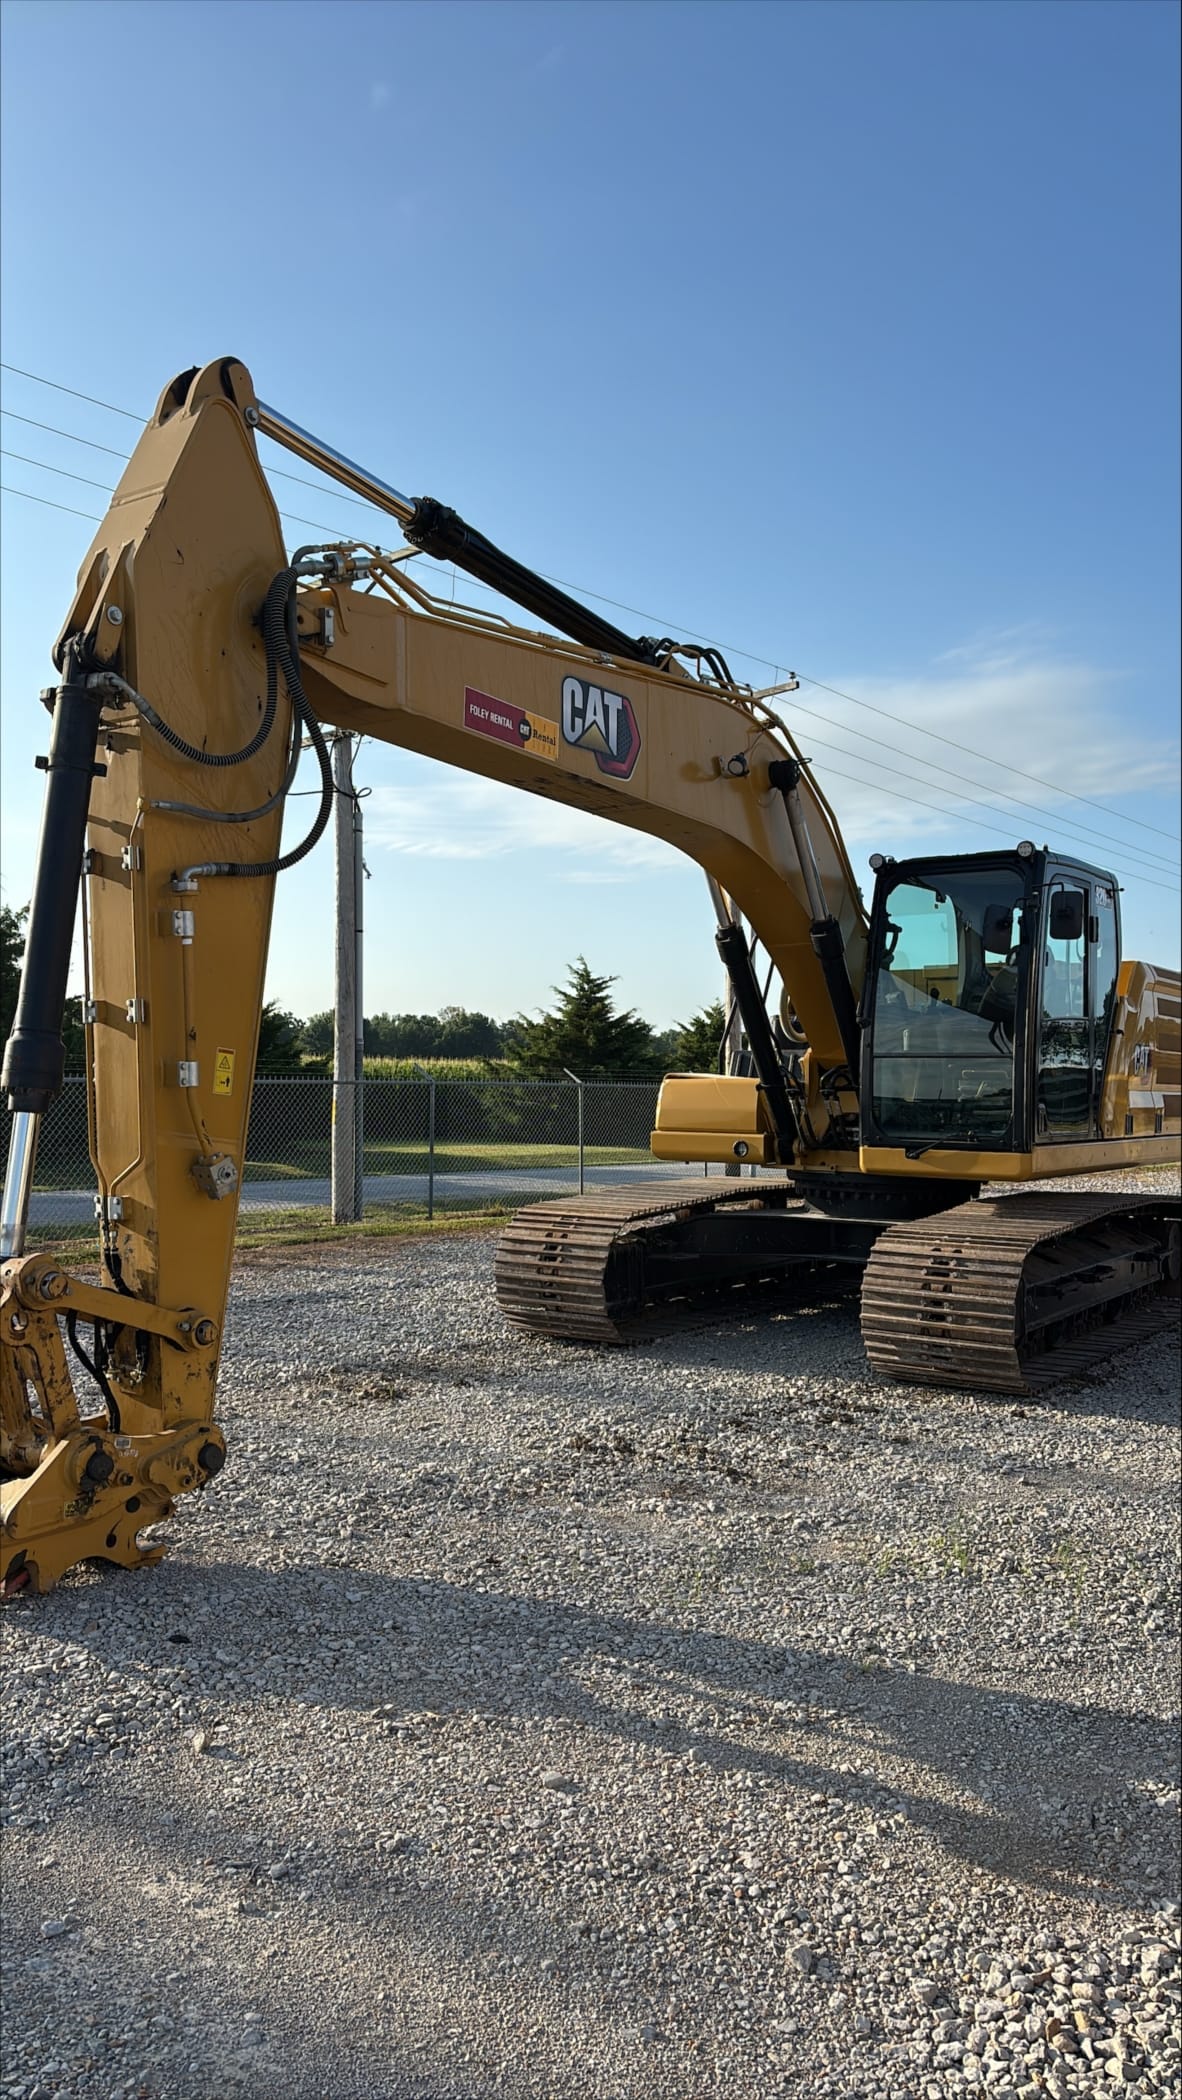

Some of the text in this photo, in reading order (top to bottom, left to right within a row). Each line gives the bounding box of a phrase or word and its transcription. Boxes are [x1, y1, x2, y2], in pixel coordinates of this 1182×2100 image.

[469, 703, 489, 720] FOLEY
[490, 711, 514, 730] RENTAL
[562, 677, 623, 756] CAT
[519, 723, 530, 736] CAT
[532, 728, 556, 746] Rental
[1134, 1044, 1150, 1077] CAT
